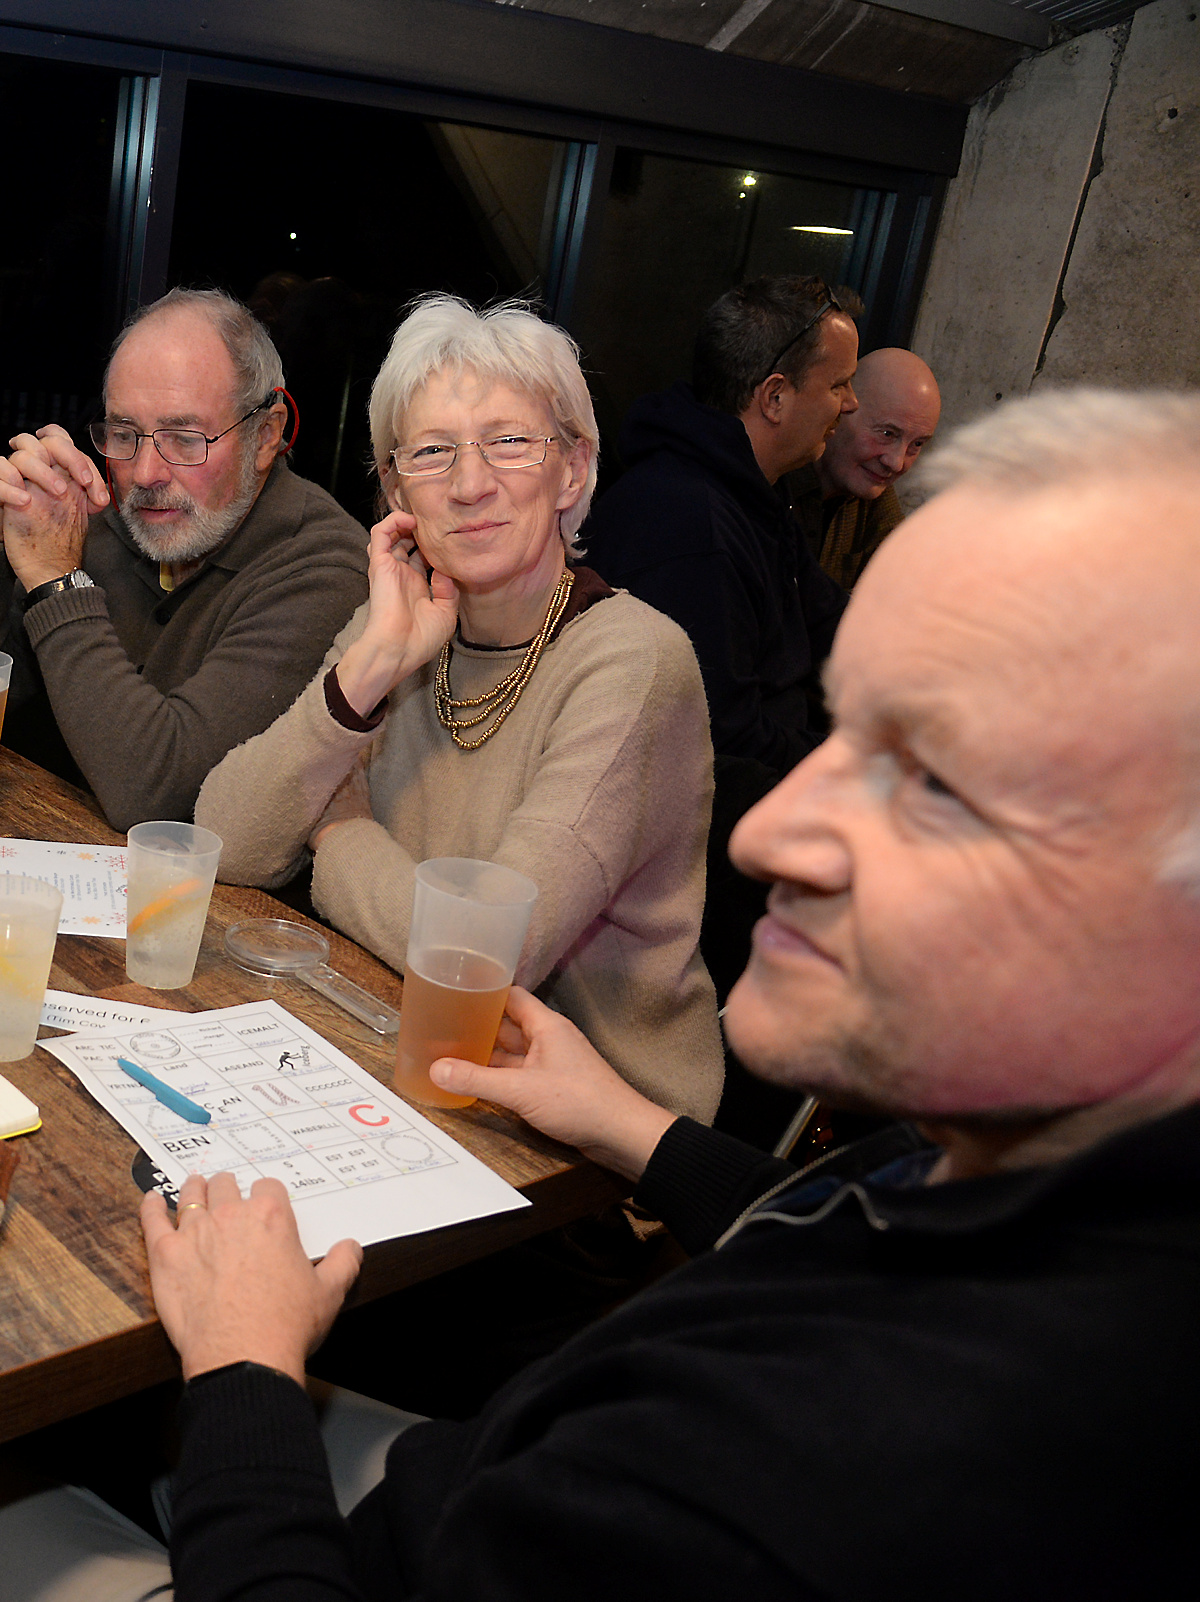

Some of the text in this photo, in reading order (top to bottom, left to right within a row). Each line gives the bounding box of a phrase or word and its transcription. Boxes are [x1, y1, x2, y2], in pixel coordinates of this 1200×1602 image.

[111, 1013, 135, 1024] for
[237, 1023, 280, 1036] ICEMALT
[100, 1043, 117, 1051] TIC
[163, 1062, 189, 1071] Land
[217, 1060, 264, 1073] LASEAND
[348, 1104, 390, 1127] C
[162, 1135, 212, 1153] BEN
[175, 1151, 199, 1160] Ben
[325, 1147, 367, 1162] EST EST
[338, 1158, 380, 1174] EST EST
[290, 1176, 327, 1189] 14lbs
